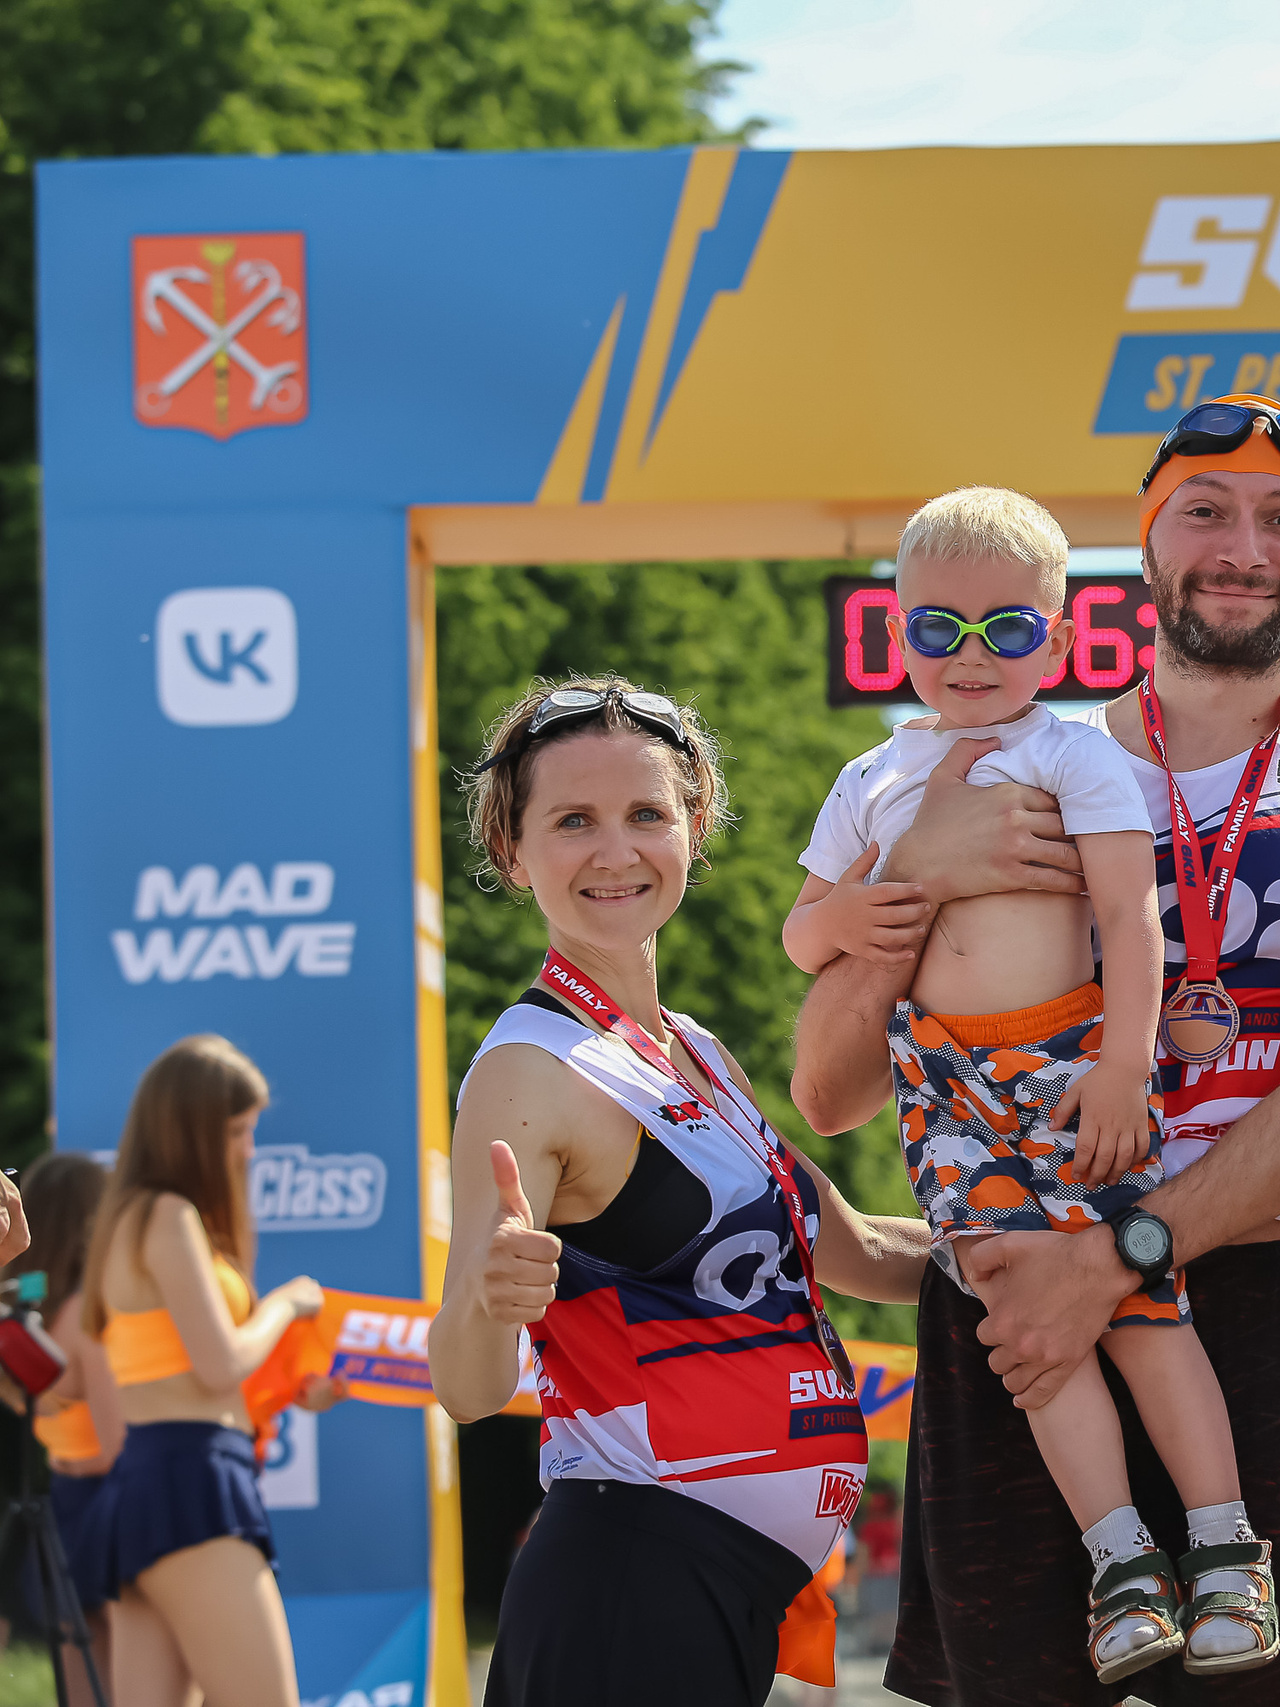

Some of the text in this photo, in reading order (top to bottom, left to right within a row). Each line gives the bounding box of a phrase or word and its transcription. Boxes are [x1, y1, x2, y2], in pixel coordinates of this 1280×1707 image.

[1244, 759, 1265, 794] 6KM
[1223, 796, 1250, 853] FAMILY
[134, 862, 335, 921] MAD
[1180, 844, 1197, 888] 6KM
[111, 922, 356, 984] WAVE
[549, 964, 609, 1012] FAMILY
[1243, 1013, 1280, 1027] ANDS
[253, 1157, 373, 1219] Class
